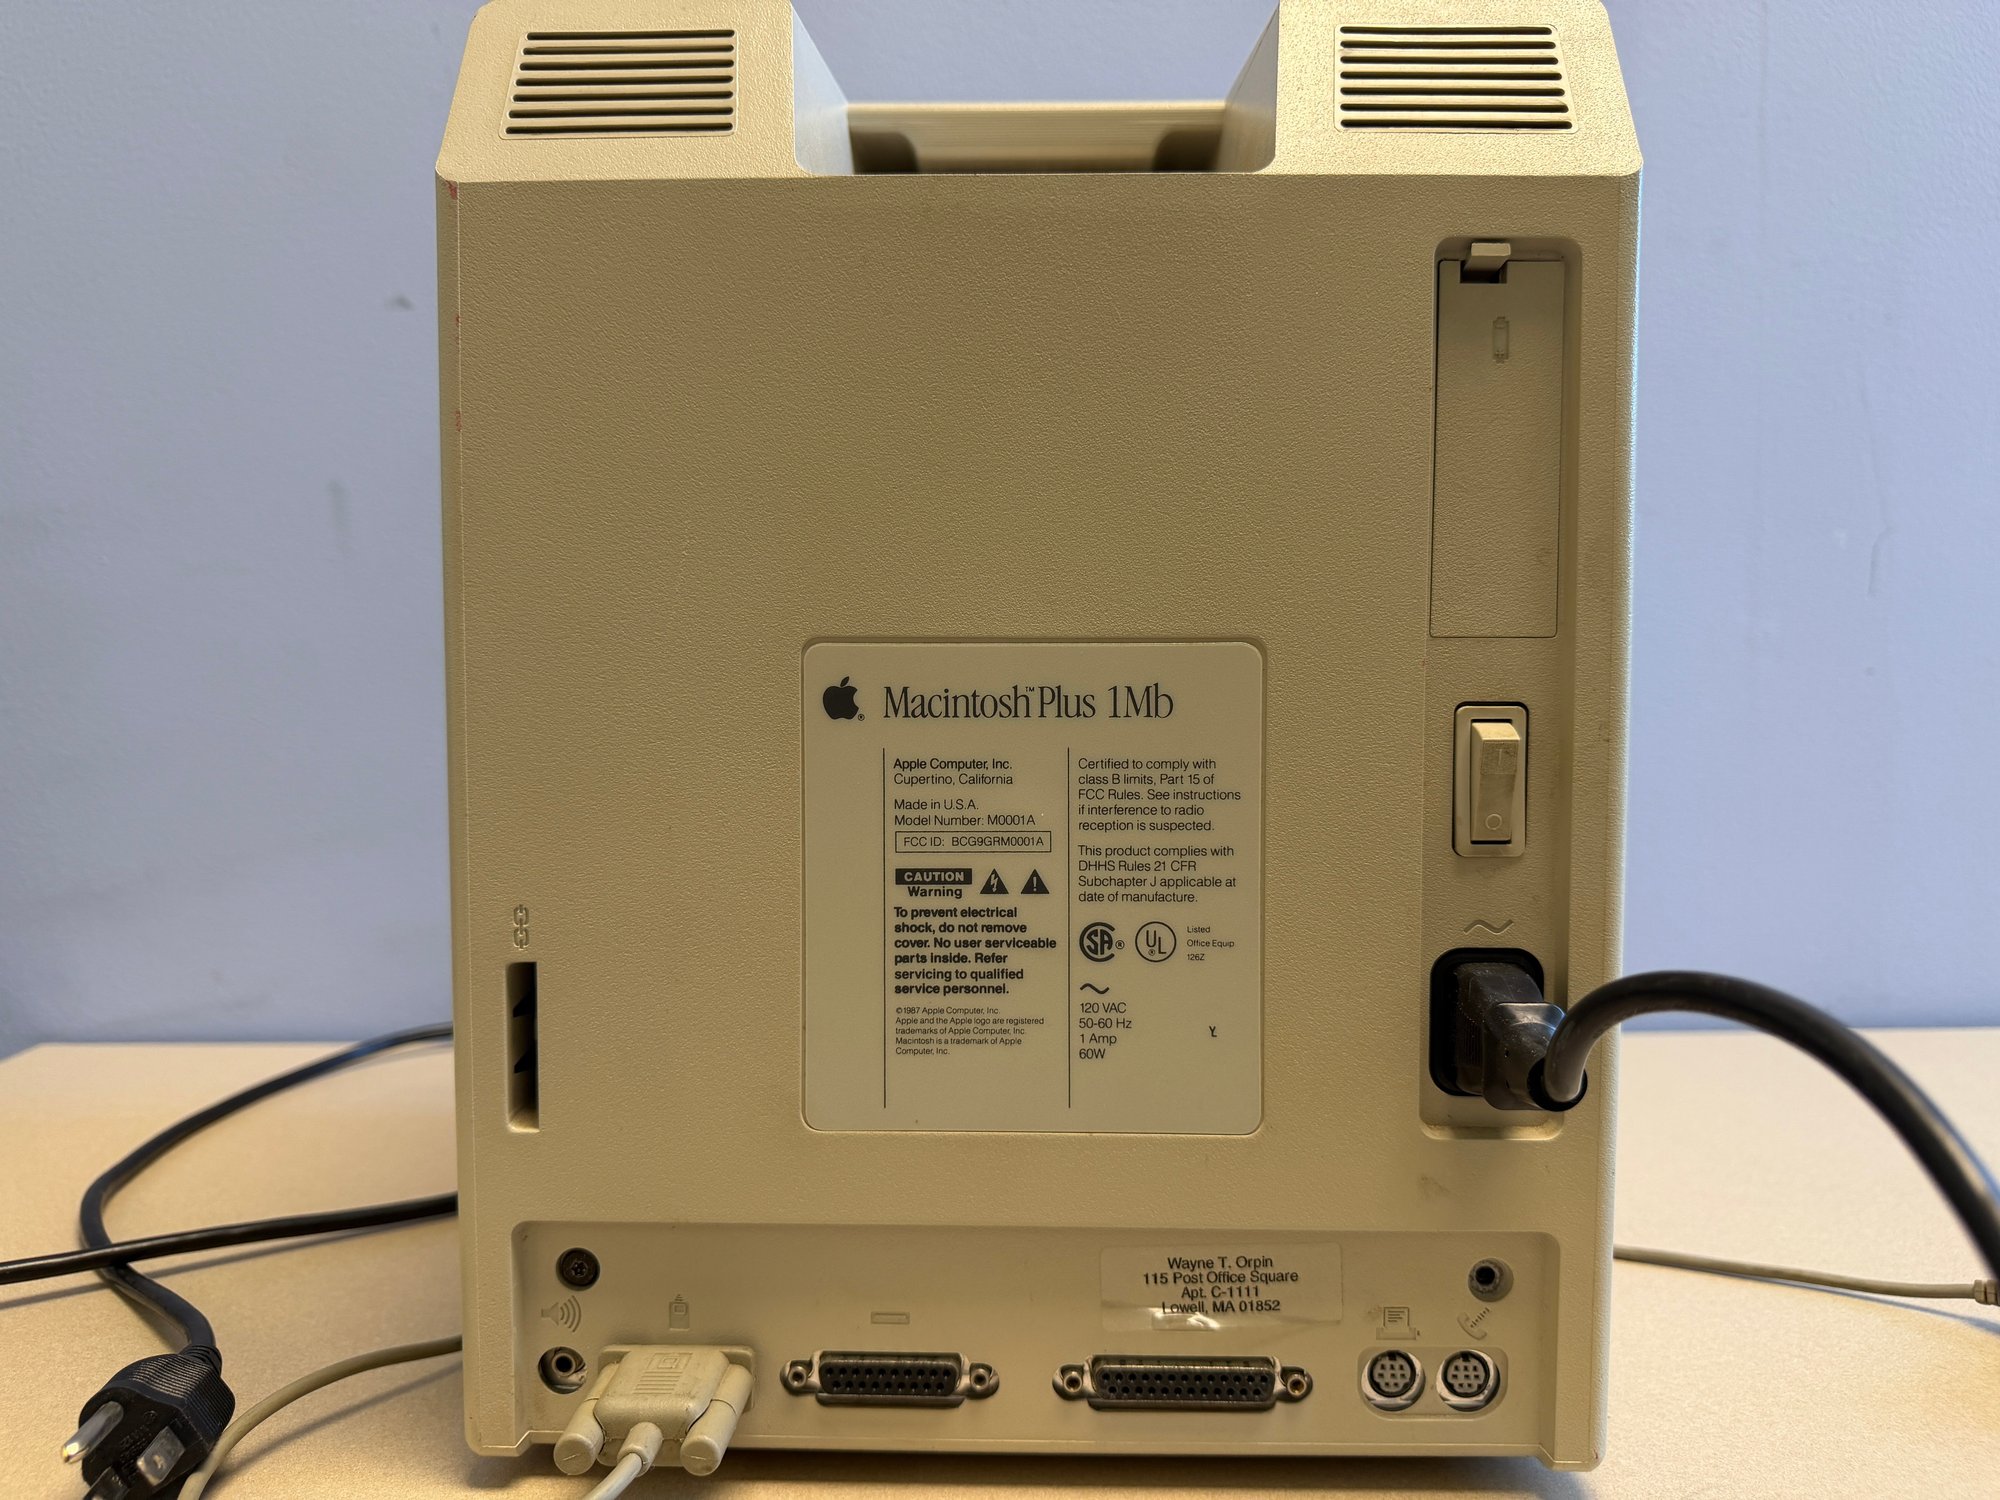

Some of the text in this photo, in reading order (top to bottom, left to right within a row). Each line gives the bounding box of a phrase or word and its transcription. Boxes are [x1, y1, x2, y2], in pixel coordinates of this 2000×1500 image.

[1038, 685, 1096, 718] Plus
[1107, 683, 1174, 718] 1Mb
[893, 758, 1012, 771] Apple Computer, Inc.
[1078, 758, 1216, 771] Certified to comply with
[894, 773, 1013, 787] Cupertino, California
[1078, 774, 1215, 785] class B limits, Part 15 of
[1078, 789, 1241, 800] FCC Rules. See instructions
[894, 799, 979, 810] Made in U.S.A.
[1078, 804, 1204, 815] if interference to radio
[894, 814, 1036, 825] Model Number: M0001A
[1078, 820, 1215, 832] reception is suspected.
[904, 836, 1044, 846] FCC ID: BCG9GRM0001A
[1078, 845, 1234, 858] This product complies with
[1078, 860, 1197, 871] DHHS Rules 21 CFR
[904, 871, 965, 882] CAUTION
[1078, 875, 1236, 889] Subchapter J applicable at
[908, 886, 963, 899] Warning
[1078, 891, 1198, 902] date of manufacture.
[894, 907, 1017, 920] To prevent electrical
[894, 922, 1027, 934] shock, do not remove
[894, 937, 1057, 948] cover. No user serviceable
[1186, 939, 1211, 947] Office
[894, 952, 1008, 966] parts inside. Refer
[894, 968, 1024, 982] servicing to qualified
[894, 983, 1009, 996] service personnel.
[922, 1007, 944, 1016] Apple
[1080, 1002, 1127, 1013] 120 VAC
[895, 1017, 919, 1026] Apple
[949, 1017, 972, 1026] Apple
[974, 1017, 990, 1026] logo
[1006, 1017, 1044, 1026] registered
[1079, 1018, 1132, 1028] 50-60 Hz
[895, 1027, 938, 1035] trademarks
[939, 1027, 947, 1035] of
[948, 1027, 971, 1036] Apple
[895, 1037, 934, 1045] Macintosh
[936, 1037, 942, 1045] is
[950, 1037, 989, 1045] trademark
[991, 1037, 999, 1045] of
[999, 1037, 1022, 1046] Apple
[1080, 1033, 1117, 1046] 1 Amp
[1079, 1048, 1105, 1059] 60W
[1167, 1256, 1273, 1272] Wayne T. Orpin
[1143, 1270, 1299, 1285] 115 Post Office Square
[1181, 1286, 1259, 1301] Apt. C-1111
[1213, 1301, 1235, 1312] MA
[1239, 1300, 1280, 1312] 01852
